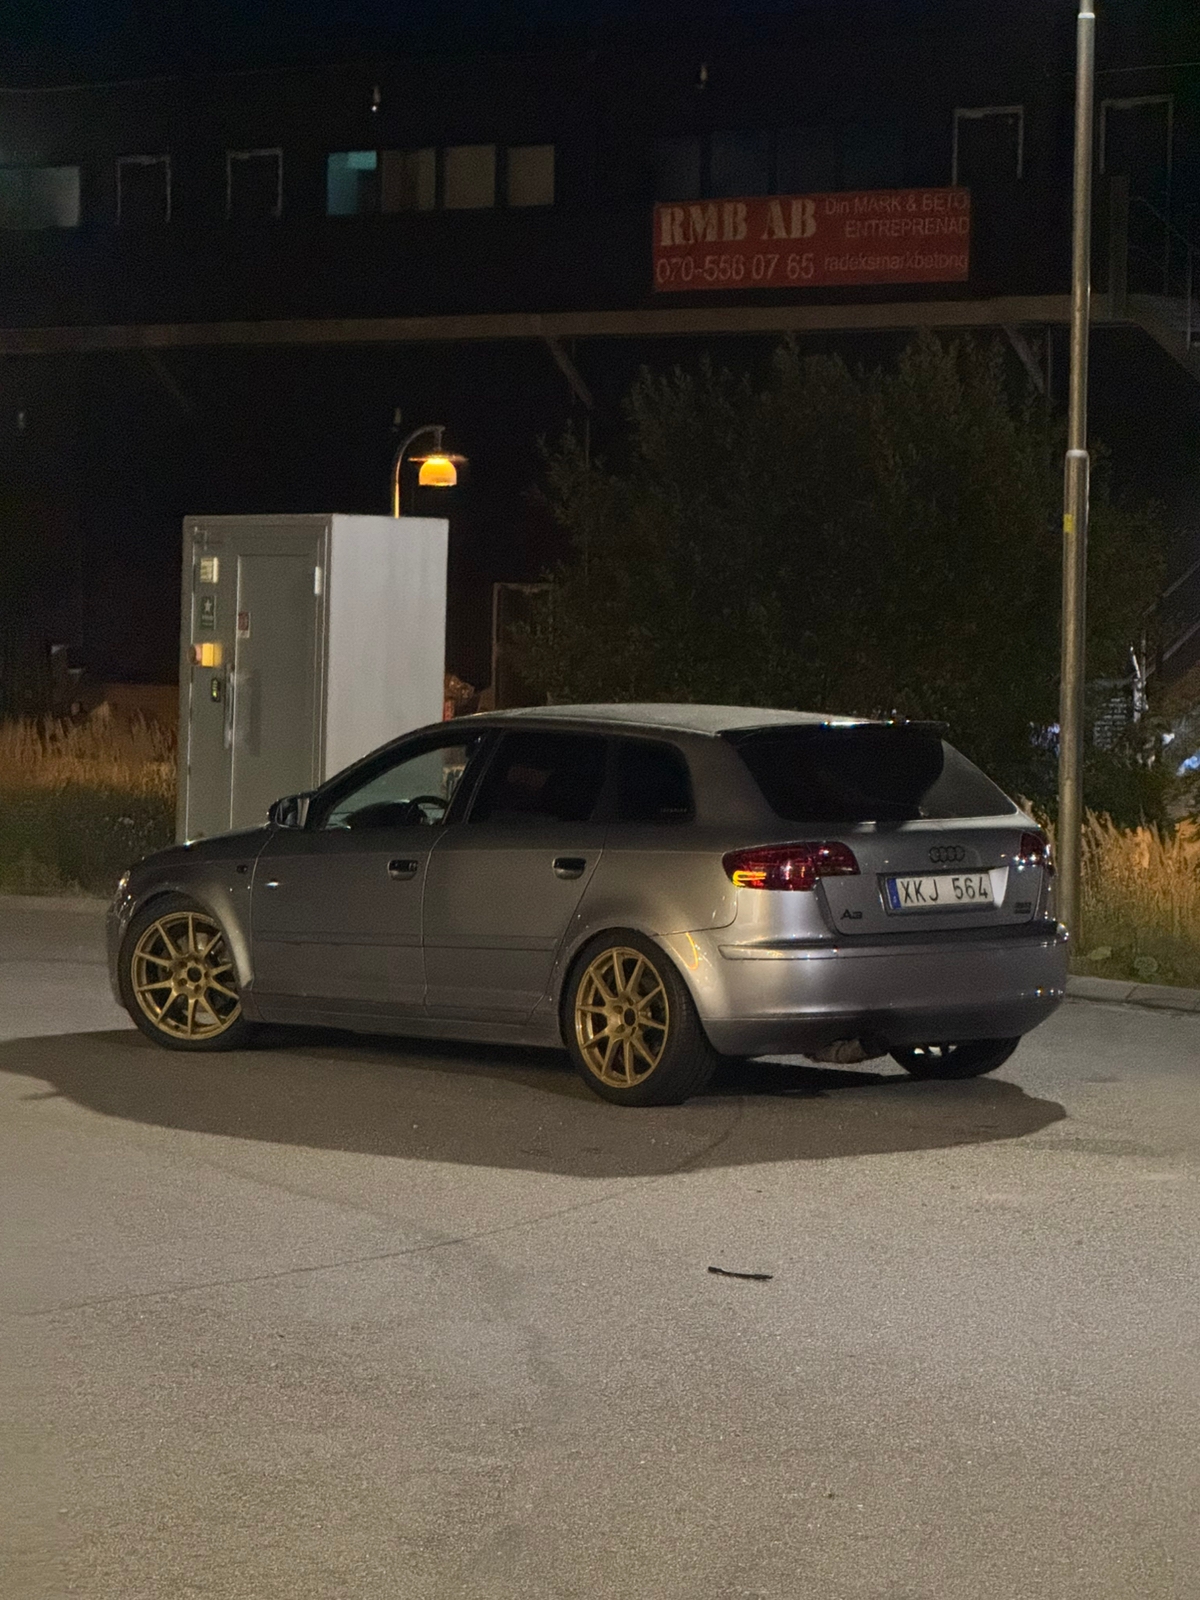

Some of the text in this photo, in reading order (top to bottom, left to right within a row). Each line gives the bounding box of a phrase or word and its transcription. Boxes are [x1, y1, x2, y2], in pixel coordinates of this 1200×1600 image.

[825, 198, 850, 215] Din
[854, 195, 901, 214] MARK
[906, 194, 916, 212] &
[659, 198, 817, 246] RMB AB
[752, 253, 780, 280] 07
[787, 253, 815, 279] 65
[900, 876, 988, 904] XKJ 564
[840, 909, 863, 920] A3
